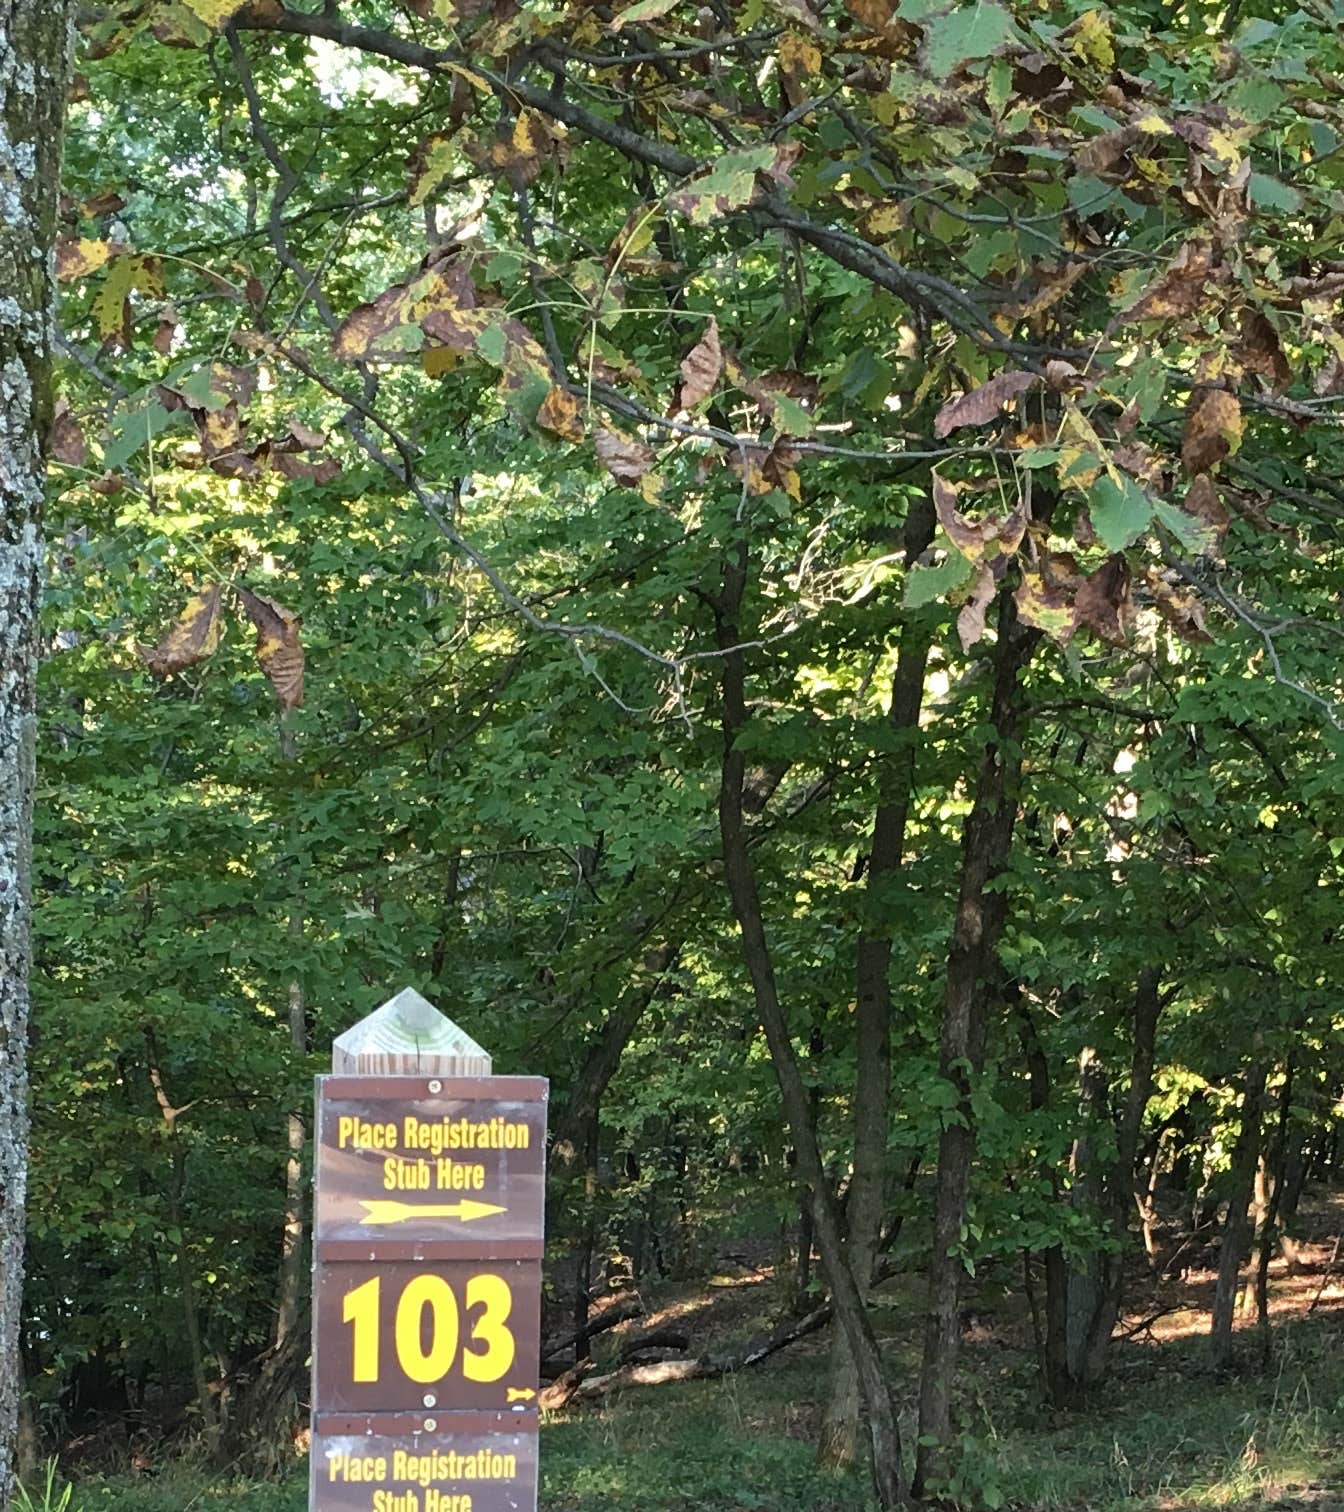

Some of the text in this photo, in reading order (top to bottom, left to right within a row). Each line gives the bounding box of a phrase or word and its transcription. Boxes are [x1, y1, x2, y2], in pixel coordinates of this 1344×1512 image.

[338, 1116, 529, 1154] Place Registration
[383, 1158, 485, 1190] Stub Here
[342, 1274, 516, 1383] 103
[329, 1449, 516, 1487] Place Registration
